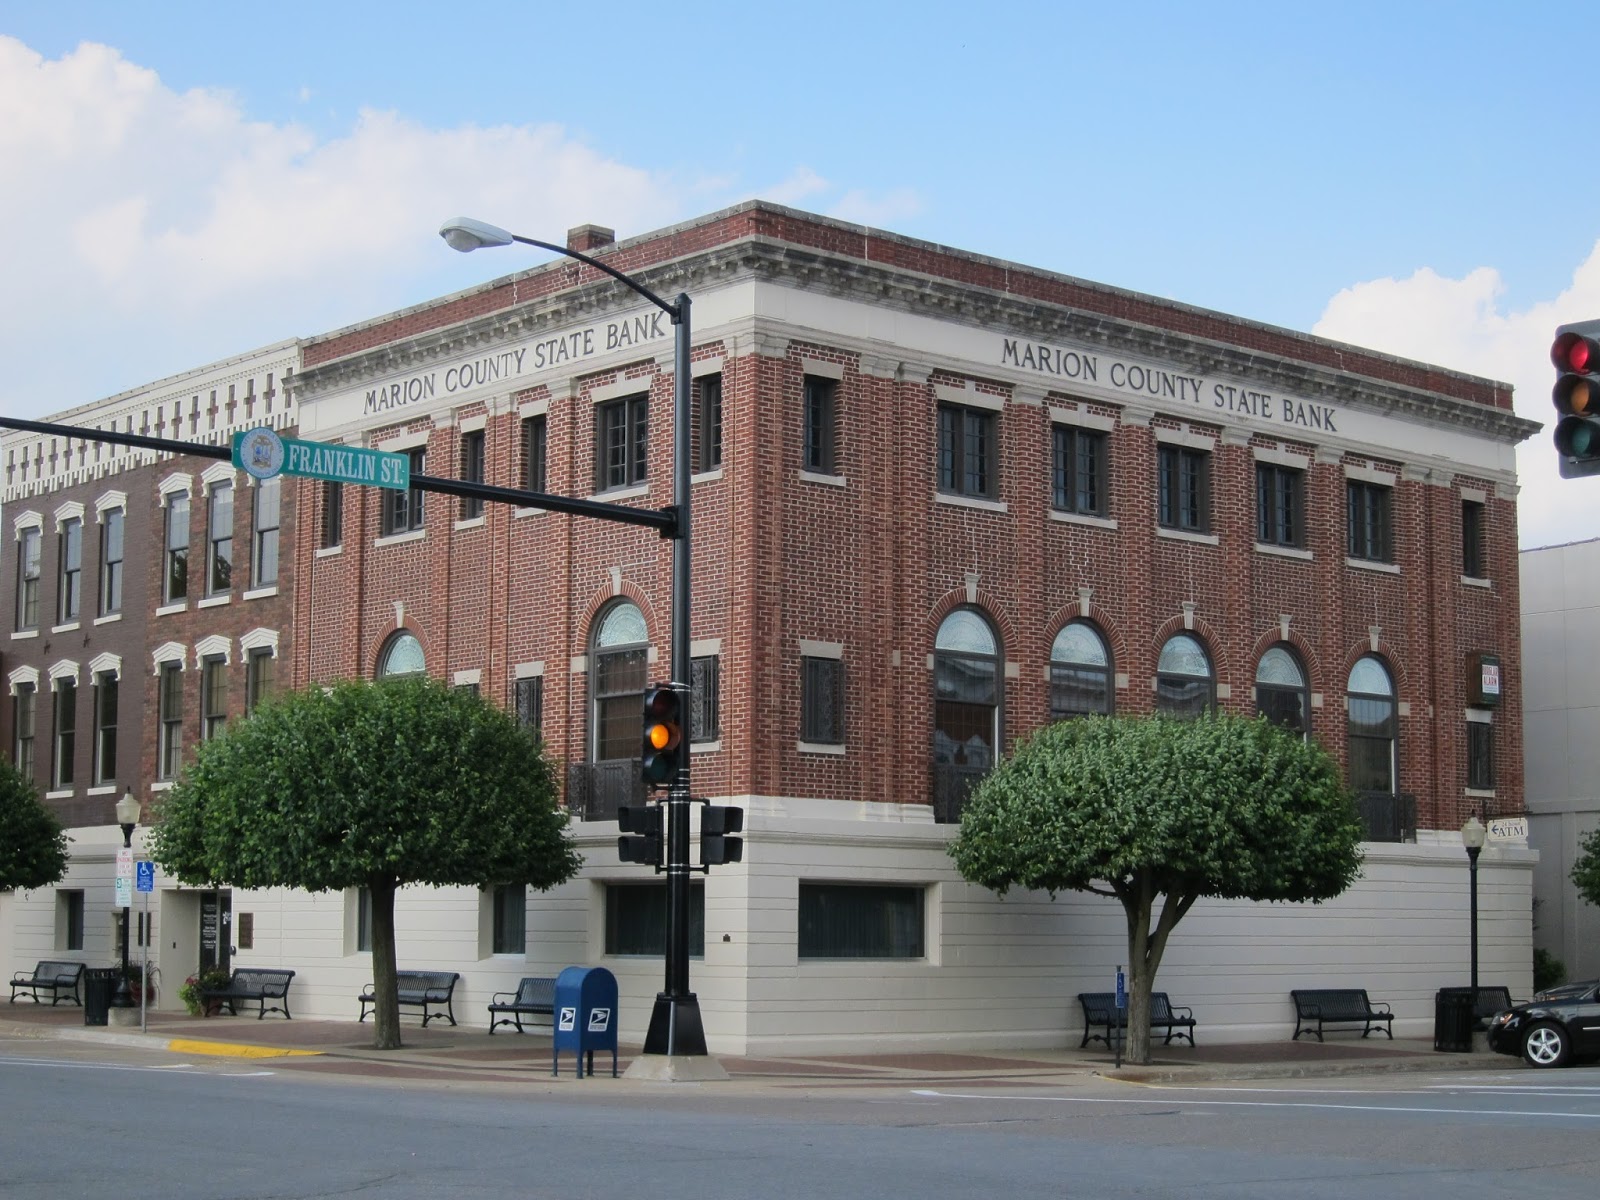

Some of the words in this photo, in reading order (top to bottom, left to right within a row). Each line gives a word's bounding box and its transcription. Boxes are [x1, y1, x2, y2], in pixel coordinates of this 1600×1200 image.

[363, 372, 436, 415] MARION
[445, 348, 526, 392] COUNTY
[534, 328, 594, 368] STATE
[606, 310, 666, 350] BANK
[1001, 338, 1098, 382] MARION
[1110, 362, 1203, 403] COUNTY
[1213, 383, 1273, 419] STATE
[1282, 399, 1338, 433] BANK
[288, 444, 376, 481] FRANKLIN
[381, 456, 403, 484] ST.
[1497, 826, 1524, 837] ATM
